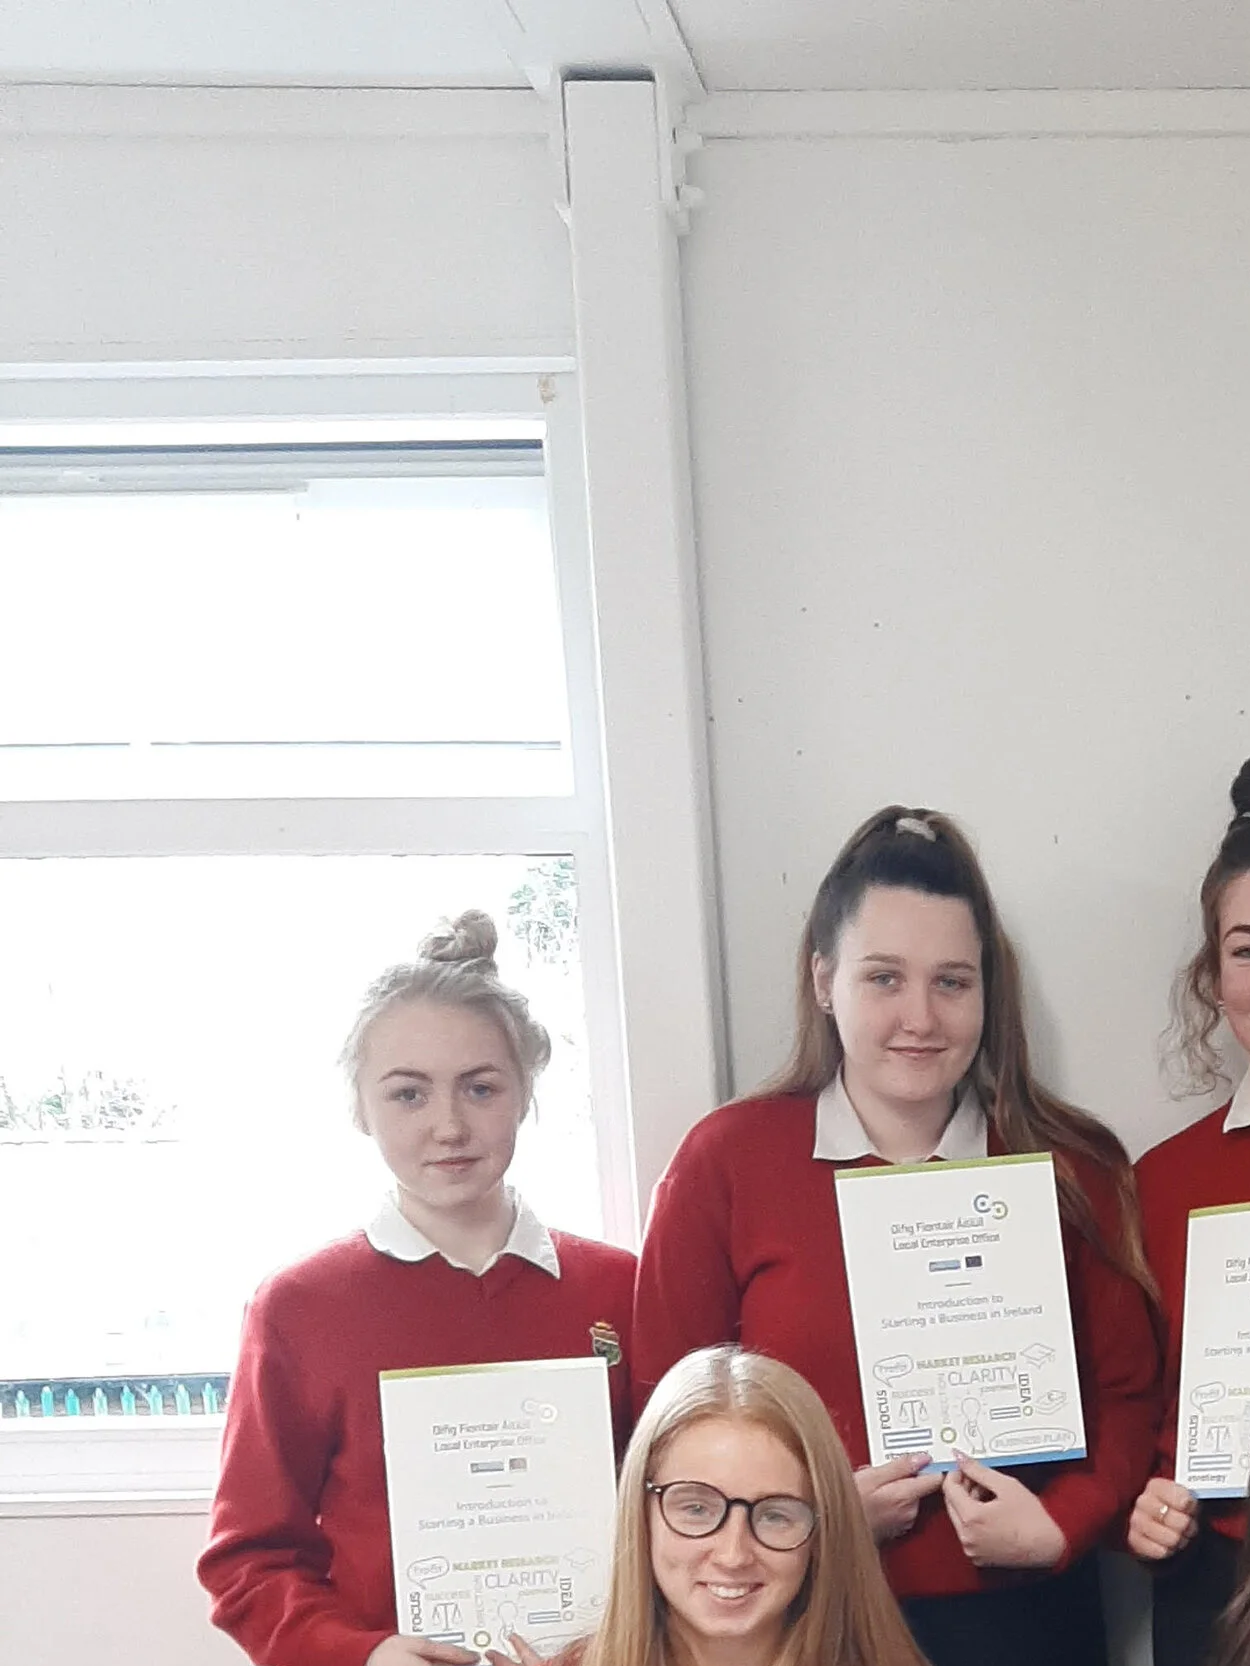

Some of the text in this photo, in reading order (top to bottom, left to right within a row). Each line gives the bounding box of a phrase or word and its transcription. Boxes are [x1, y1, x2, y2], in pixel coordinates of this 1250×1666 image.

[917, 1296, 989, 1311] Introduction
[881, 1317, 926, 1329] Starting
[938, 1311, 988, 1324] Business
[1003, 1304, 1042, 1318] Ireland
[948, 1366, 1019, 1386] CLARITY
[1018, 1373, 1032, 1404] IDEA
[877, 1390, 892, 1430] FOCUS
